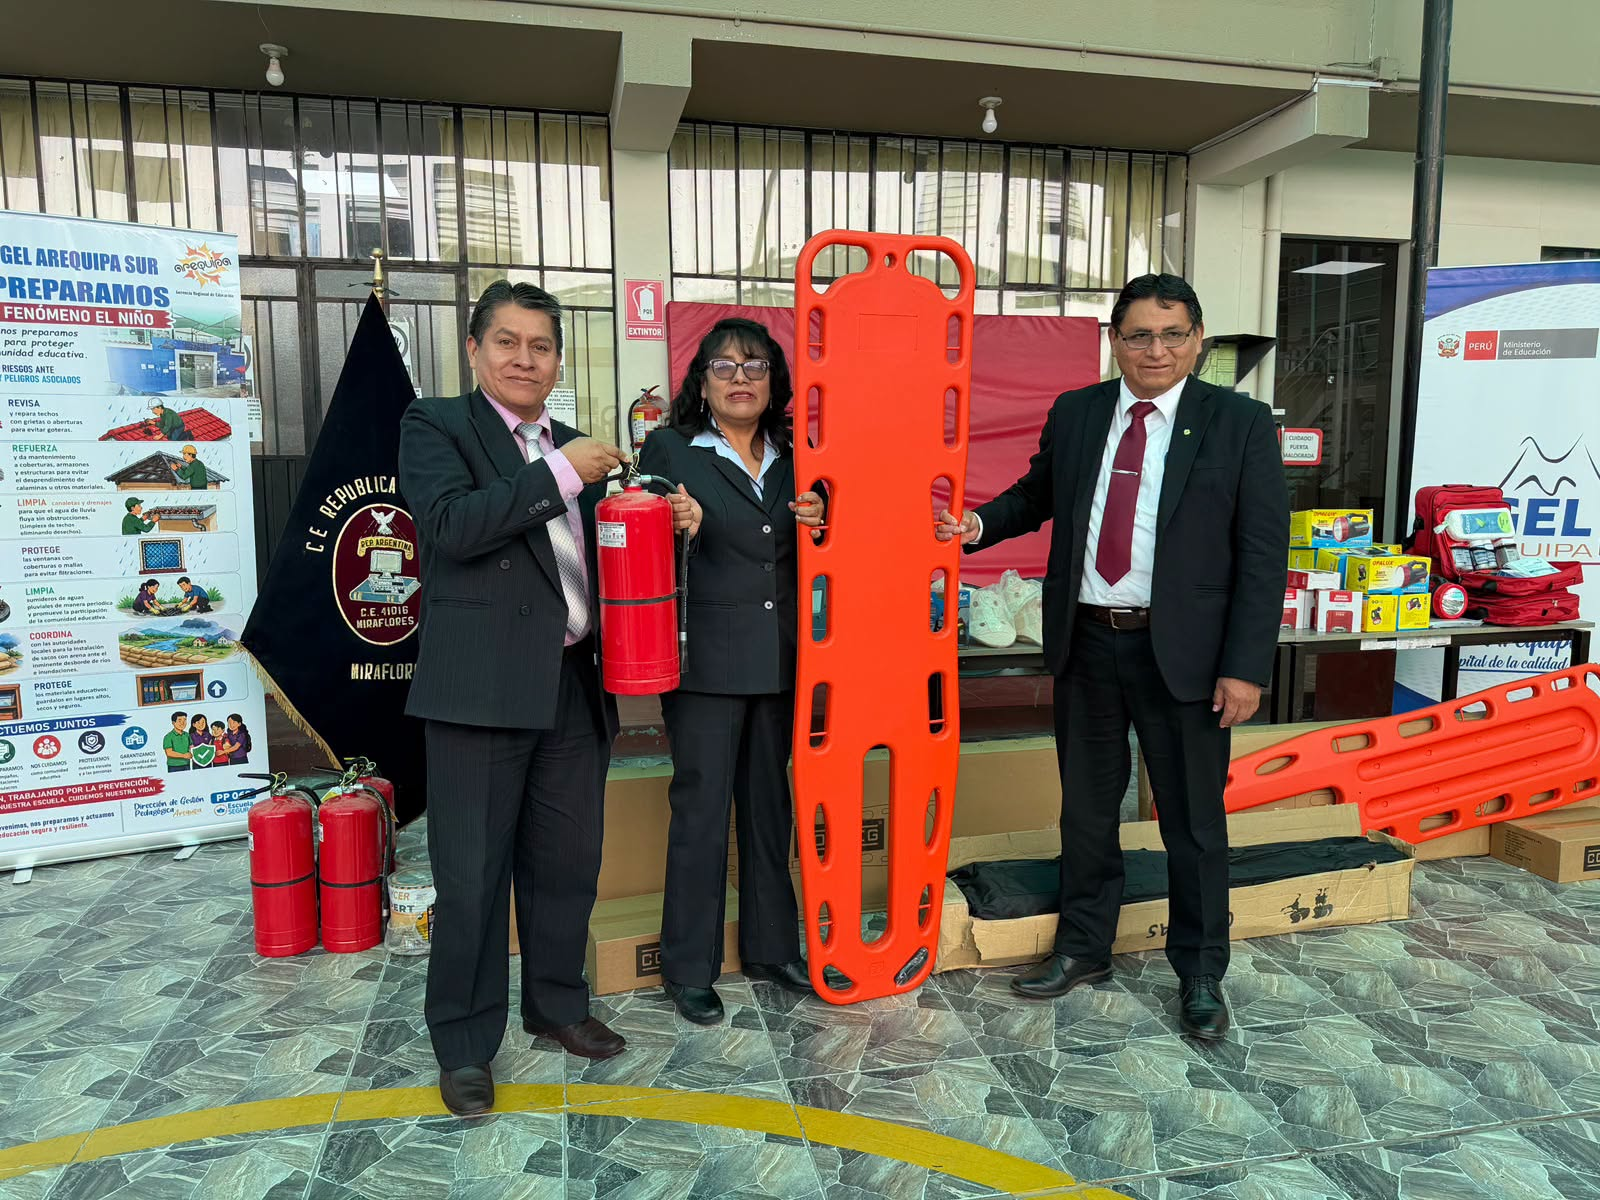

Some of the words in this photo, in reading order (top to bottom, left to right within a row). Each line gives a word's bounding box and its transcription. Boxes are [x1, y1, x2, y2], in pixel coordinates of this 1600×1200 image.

[0, 245, 32, 266] GEL
[36, 248, 122, 272] AREQUIPA
[125, 255, 158, 275] SUR
[174, 257, 232, 273] arequipa
[4, 305, 90, 322] FENÓMENO
[95, 311, 114, 324] EL
[118, 310, 154, 326] NIÑO
[22, 329, 79, 337] preparamos
[628, 327, 662, 337] EXTINTOR
[4, 339, 26, 347] para
[31, 340, 75, 349] proteger
[1468, 341, 1493, 350] PERÚ
[1503, 341, 1541, 349] Ministerio
[38, 350, 88, 359] educativa.
[1514, 348, 1551, 356] Educación
[2, 364, 34, 373] RIESGOS
[35, 365, 55, 374] ANTE
[4, 374, 40, 383] PELIGROS
[42, 375, 82, 384] ASOCIADOS
[8, 399, 41, 408] REVISA
[12, 444, 58, 453] REFUERZA
[319, 475, 396, 519] REPUBLICA
[17, 499, 47, 507] LIMPIA
[21, 546, 61, 555] PROTEGE
[375, 539, 412, 552] ARGENTINA
[25, 587, 54, 596] LIMPIA
[360, 608, 379, 617] C.E.
[380, 605, 409, 616] 41016
[356, 616, 415, 629] MIRAFLORES
[29, 630, 73, 640] COORDINA
[1488, 655, 1505, 669] de
[1505, 655, 1520, 669] la
[1520, 656, 1569, 670] calidad
[350, 663, 417, 680] MIRAFLOR
[34, 680, 72, 691] PROTEGE
[45, 689, 75, 697] materiales
[74, 694, 95, 702] lugares
[53, 718, 96, 730] JUNTOS
[8, 788, 64, 801] TRABAJANDO
[66, 786, 83, 794] POR
[85, 784, 97, 792] LA
[98, 776, 149, 791] PREVENCIÓN
[68, 792, 104, 802] CUIDEMOS
[105, 789, 137, 797] NUESTRA
[138, 786, 156, 794] VIDA!
[216, 793, 230, 802] PP
[134, 801, 167, 810] Dirección
[180, 796, 205, 805] Gestión
[228, 800, 253, 808] Escuela
[135, 807, 175, 818] Pedagógica
[42, 816, 79, 827] preparamos
[85, 811, 115, 820] actuamos
[31, 827, 52, 835] segura
[391, 890, 410, 901] CER
[391, 903, 415, 913] ERT
